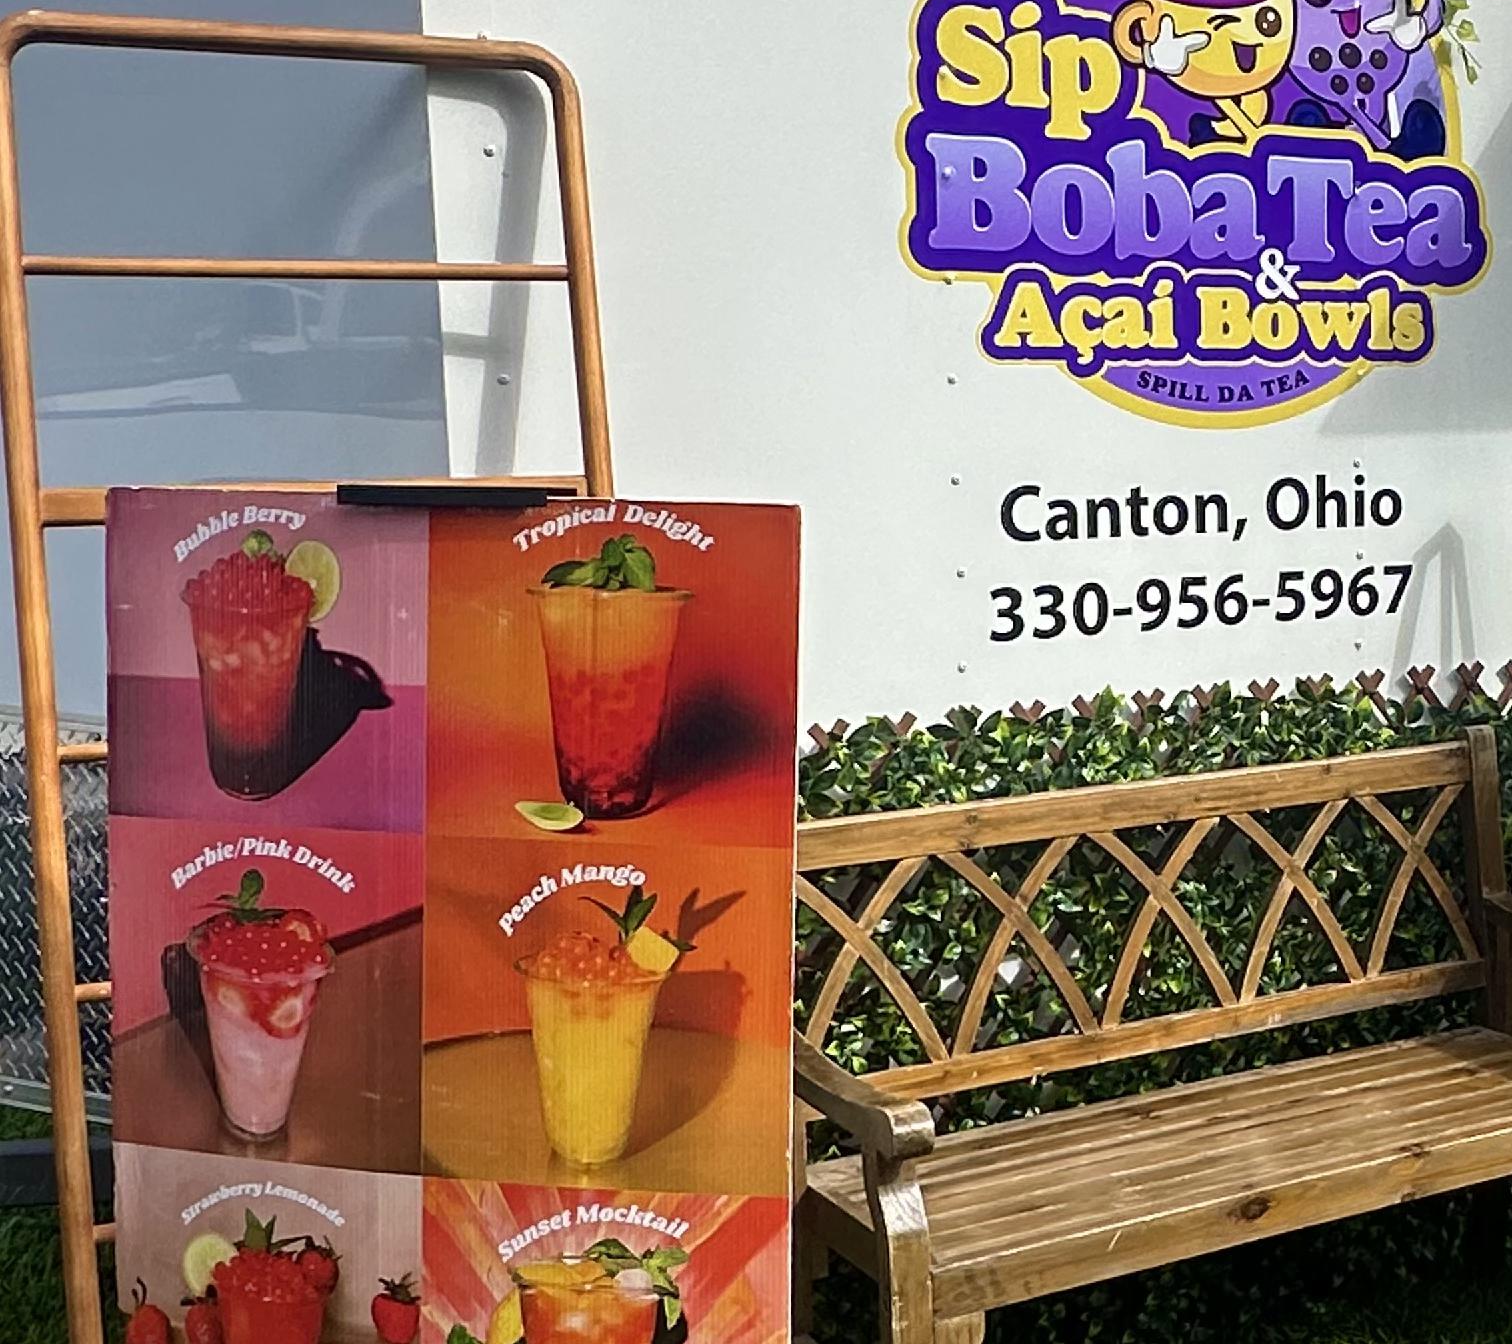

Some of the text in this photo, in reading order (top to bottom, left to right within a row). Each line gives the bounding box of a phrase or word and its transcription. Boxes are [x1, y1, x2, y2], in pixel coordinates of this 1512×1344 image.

[936, 1, 1122, 141] Sip
[926, 133, 1473, 266] Boba Tea
[1256, 249, 1303, 301] &
[1196, 285, 1425, 353] Bowls
[1136, 368, 1311, 404] SPILL DA TEA
[173, 505, 306, 563] Bubble Berry
[512, 503, 716, 553] Tropical Delight
[1000, 474, 1403, 542] Canton, Ohio
[989, 564, 1414, 642] 330-956-5967
[171, 836, 356, 894] Barbie/Pink Drink
[559, 863, 647, 888] Mango
[181, 1180, 346, 1228] Strawberry Lemonade
[497, 1203, 690, 1264] Sunset Mocktail
